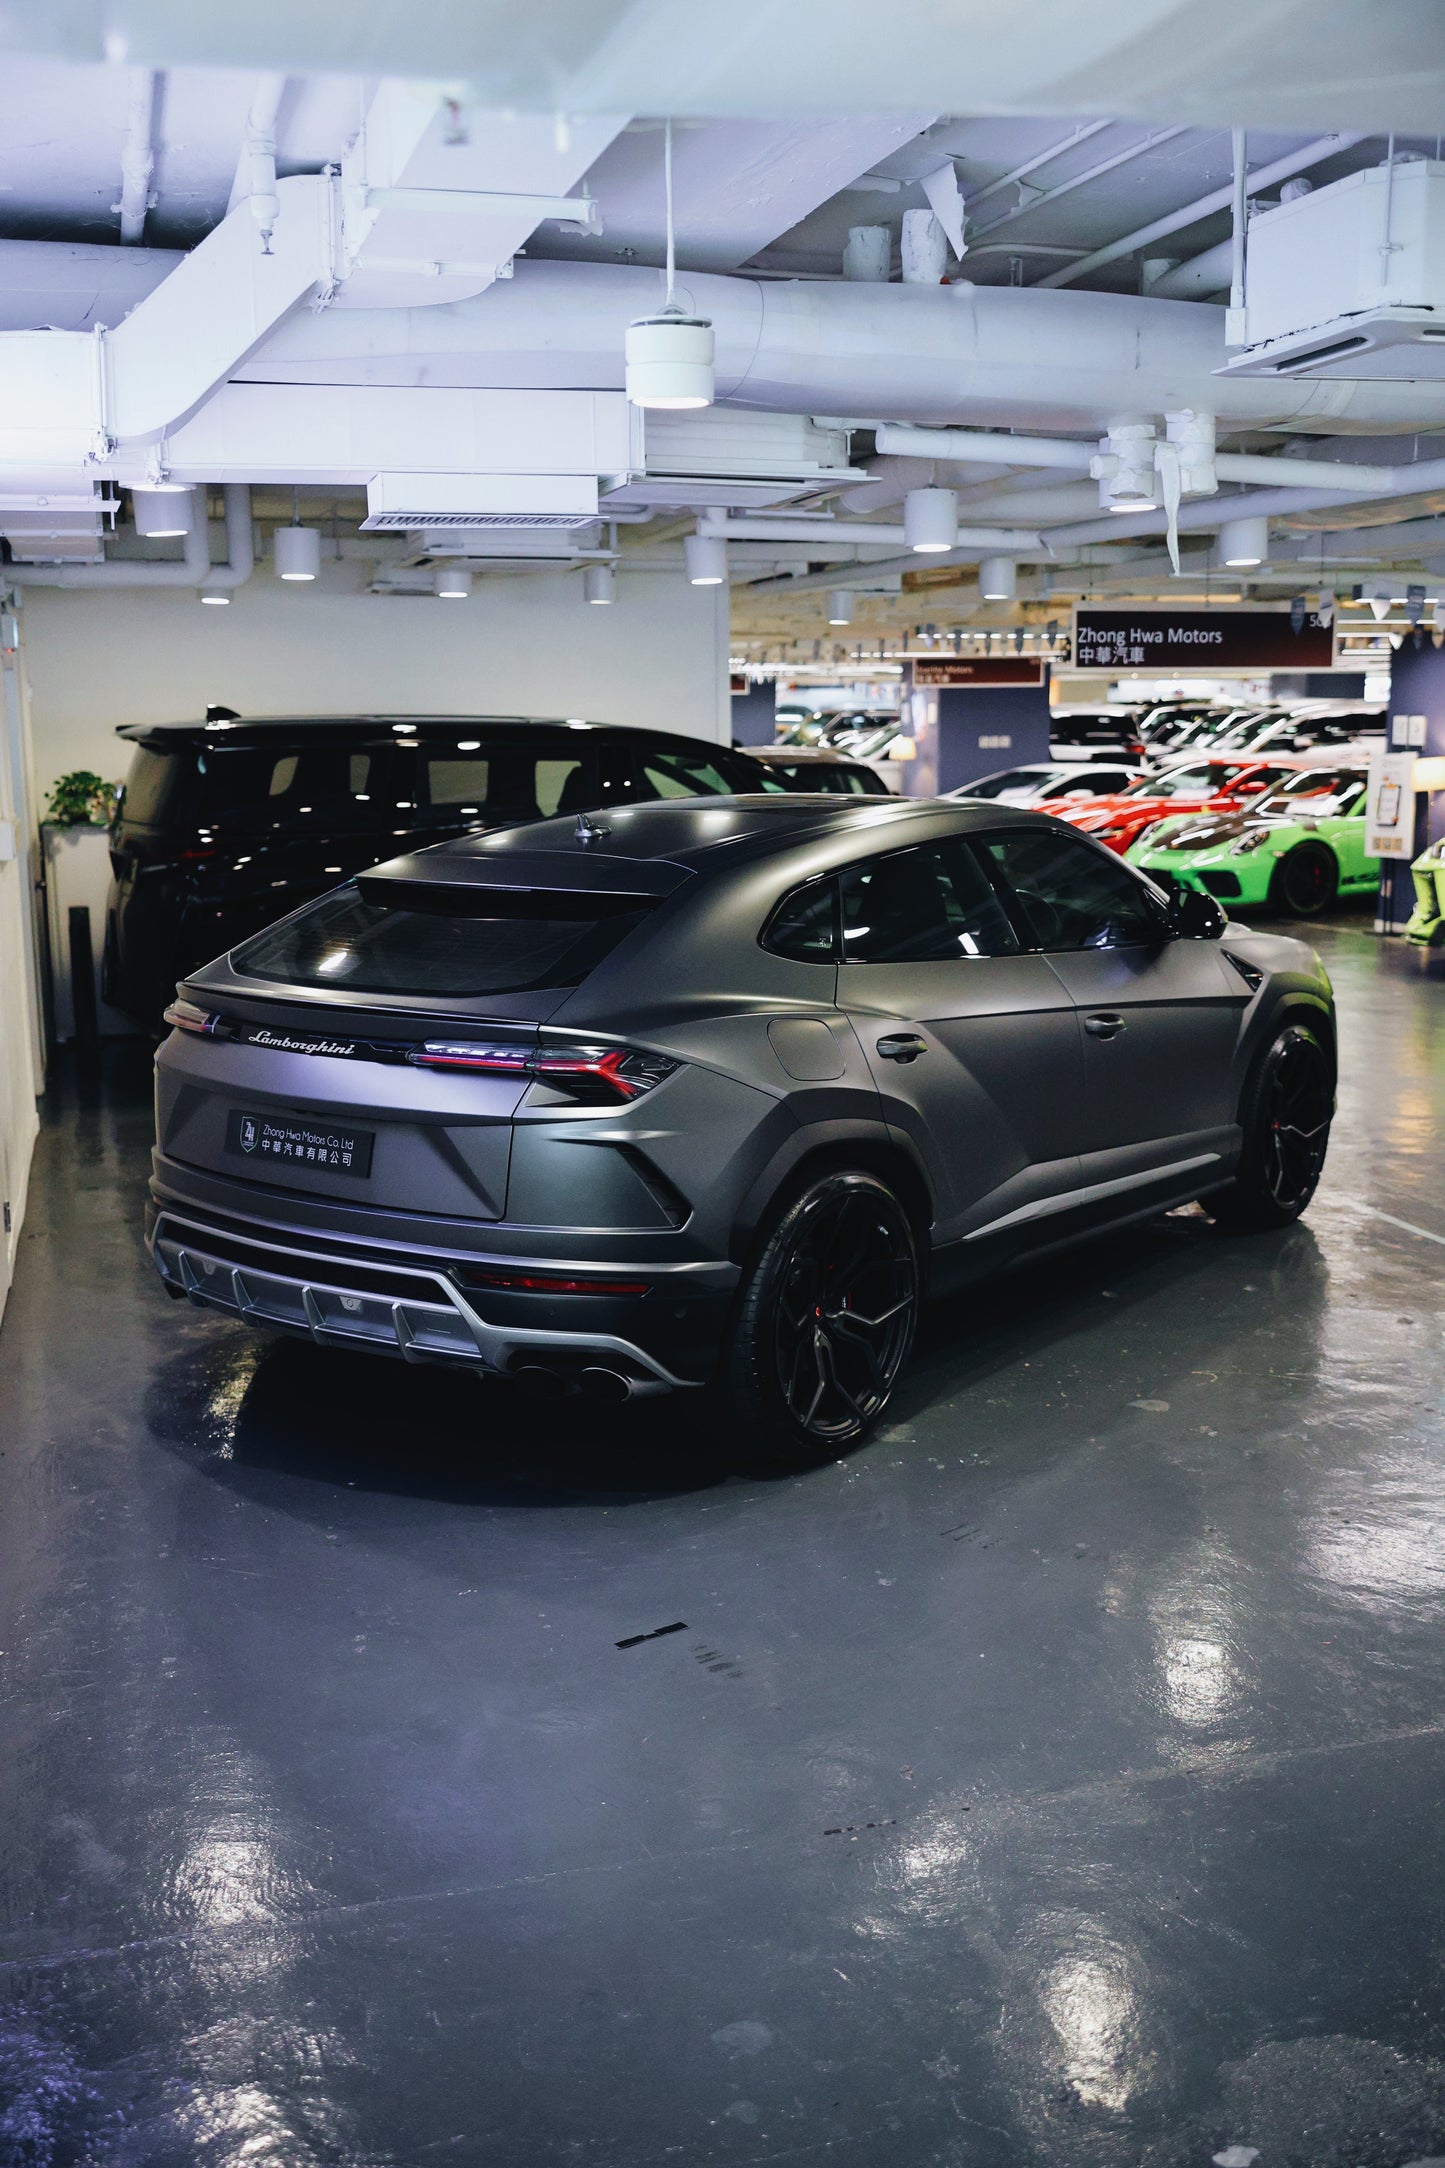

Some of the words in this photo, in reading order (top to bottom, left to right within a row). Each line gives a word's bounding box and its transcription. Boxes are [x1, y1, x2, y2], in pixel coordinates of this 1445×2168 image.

[1078, 627, 1126, 647] Zhong
[1130, 628, 1163, 643] Hwa
[1168, 628, 1223, 644] Motors
[1079, 646, 1145, 664] 中華汽車
[248, 1030, 355, 1055] Lamborghini
[262, 1124, 285, 1139] Zhong
[286, 1128, 301, 1141] Hwa
[302, 1131, 326, 1145] Motors
[327, 1135, 339, 1148] Co.
[341, 1138, 354, 1150] Ltd
[261, 1140, 352, 1167] 中華汽車有限公司
